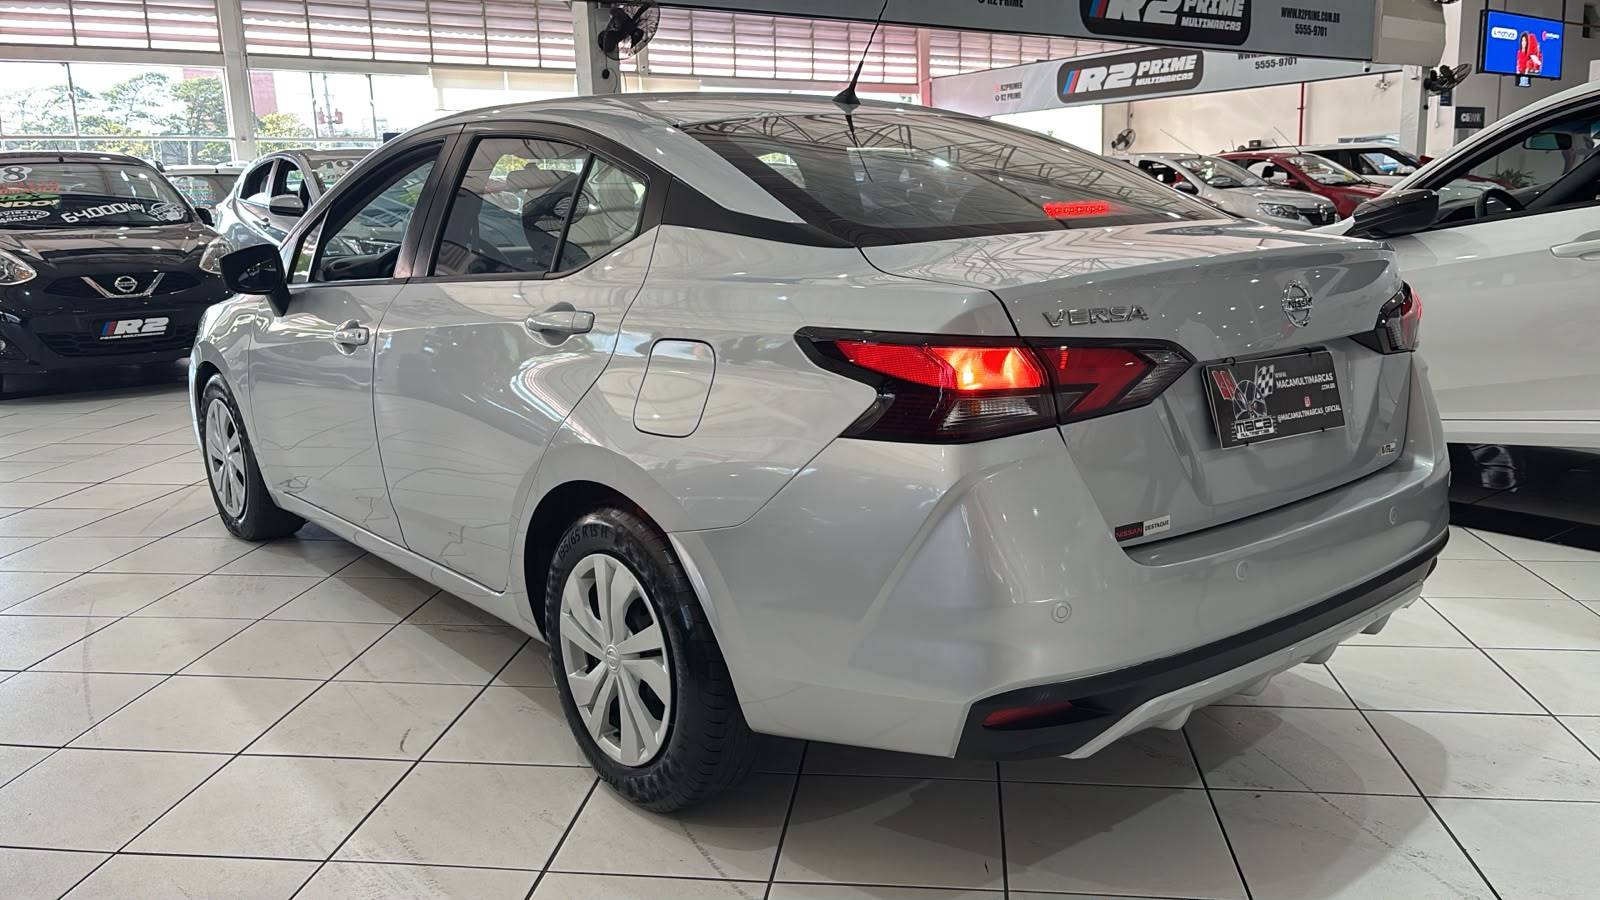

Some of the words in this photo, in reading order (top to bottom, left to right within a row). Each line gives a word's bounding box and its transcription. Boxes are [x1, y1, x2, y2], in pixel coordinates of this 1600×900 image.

[1183, 0, 1244, 17] PRIME
[1180, 17, 1242, 31] MULTIMARCAS
[1295, 23, 1327, 36] 5555-9701
[1255, 56, 1297, 69] 5555-9701
[1074, 62, 1137, 93] R2
[1137, 54, 1198, 76] PRIME
[1135, 72, 1194, 86] MULTIMARCAS
[1042, 305, 1149, 327] VERSA
[113, 317, 169, 335] R2
[1276, 373, 1334, 389] MACAMULTIMARCAS
[1277, 405, 1342, 423] @MACAMULTIMARCAS_OFICIAL
[1144, 520, 1169, 531] DESTAQUE
